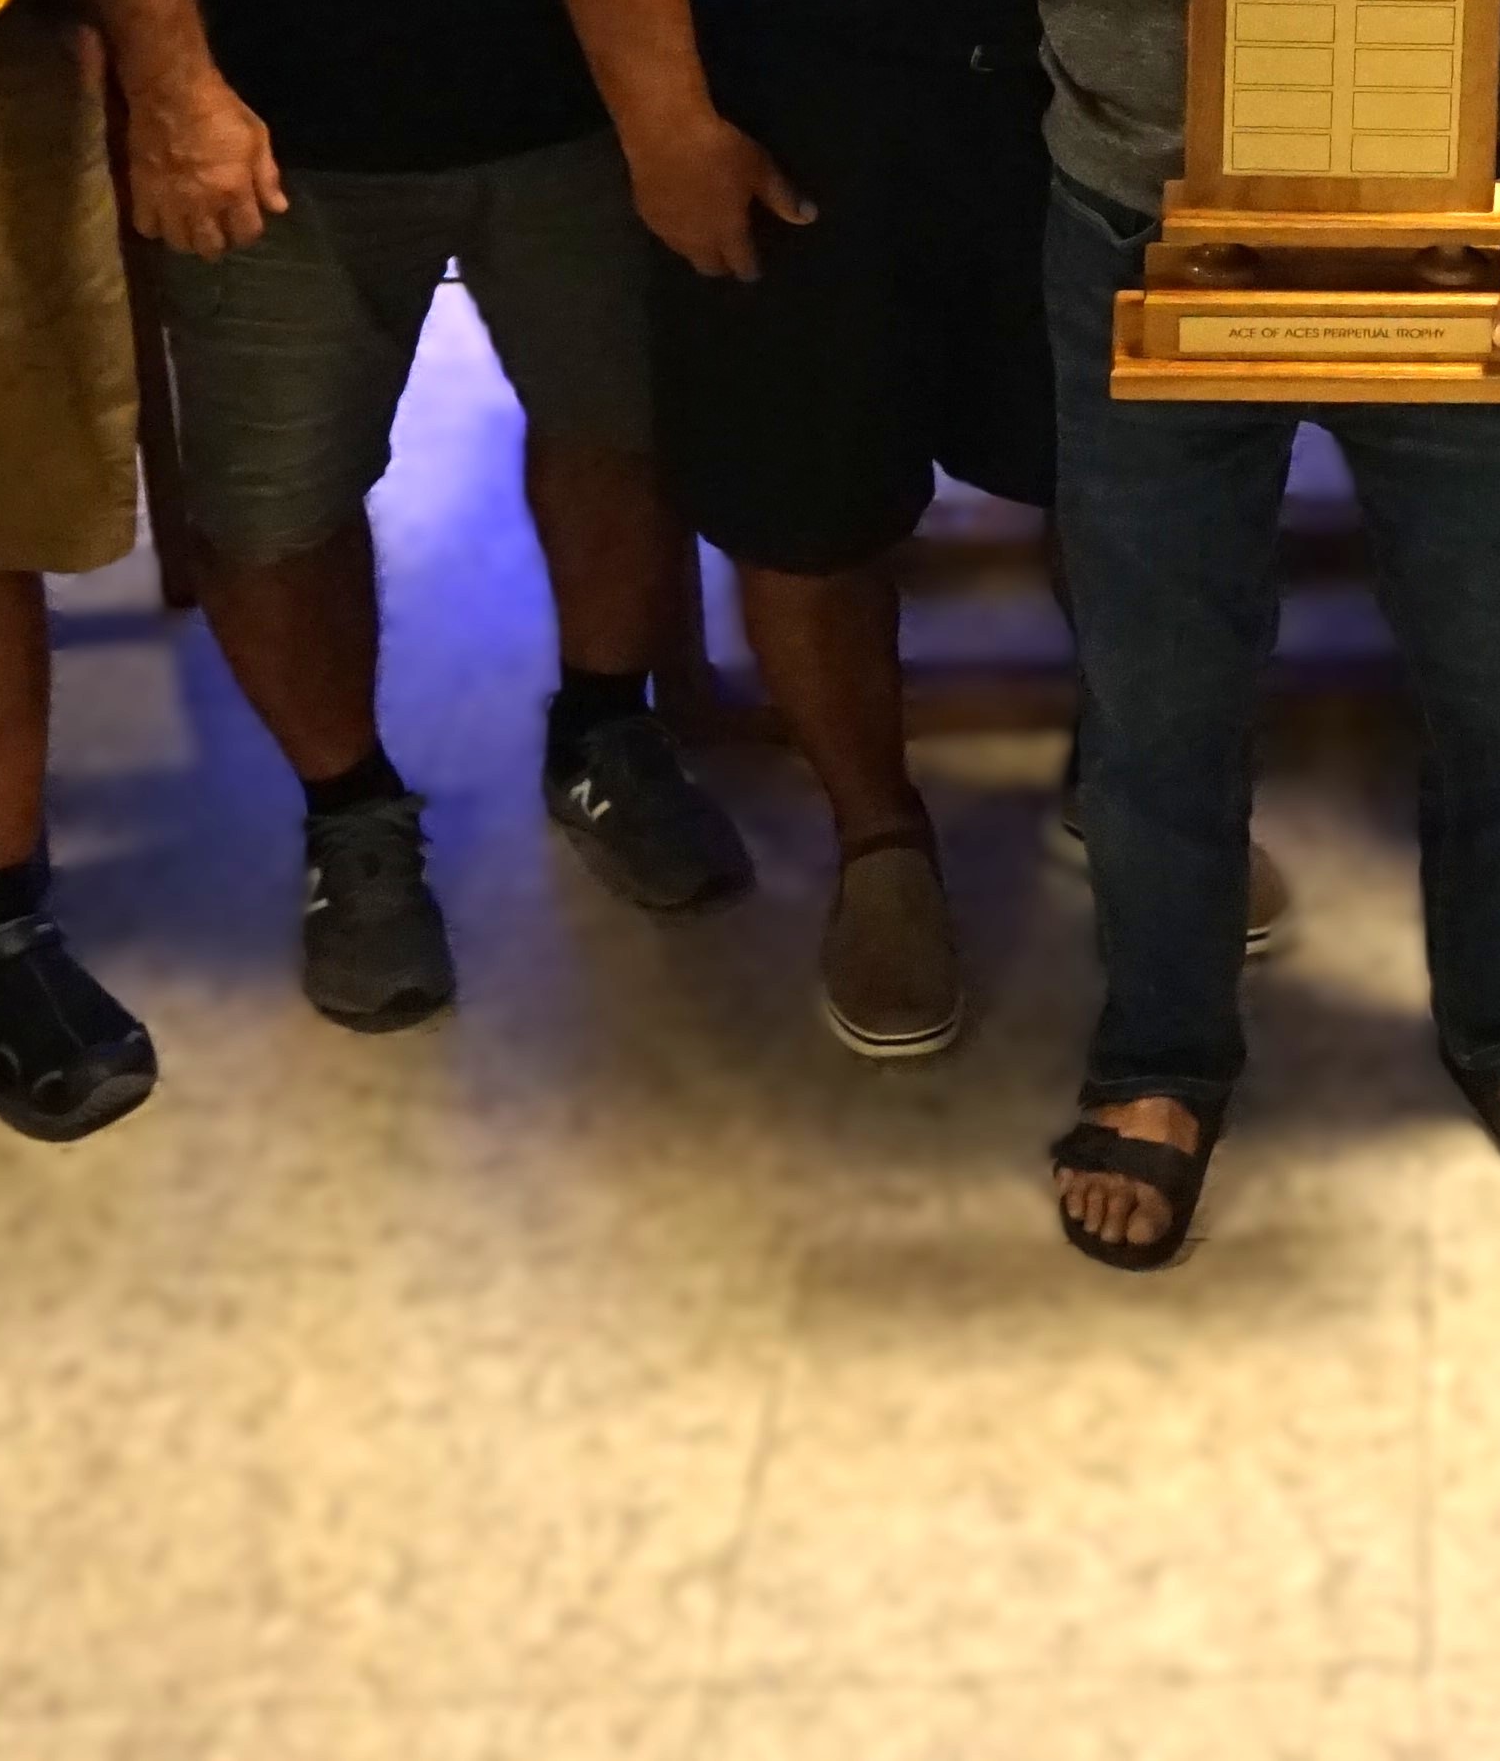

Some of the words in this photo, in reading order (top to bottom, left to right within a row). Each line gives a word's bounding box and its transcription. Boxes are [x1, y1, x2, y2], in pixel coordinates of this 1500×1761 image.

[1228, 327, 1256, 339] ACE
[1261, 327, 1279, 339] OF
[1284, 327, 1320, 339] ACES
[1323, 327, 1389, 339] PERPETUAL
[1396, 327, 1445, 339] TROPHY
